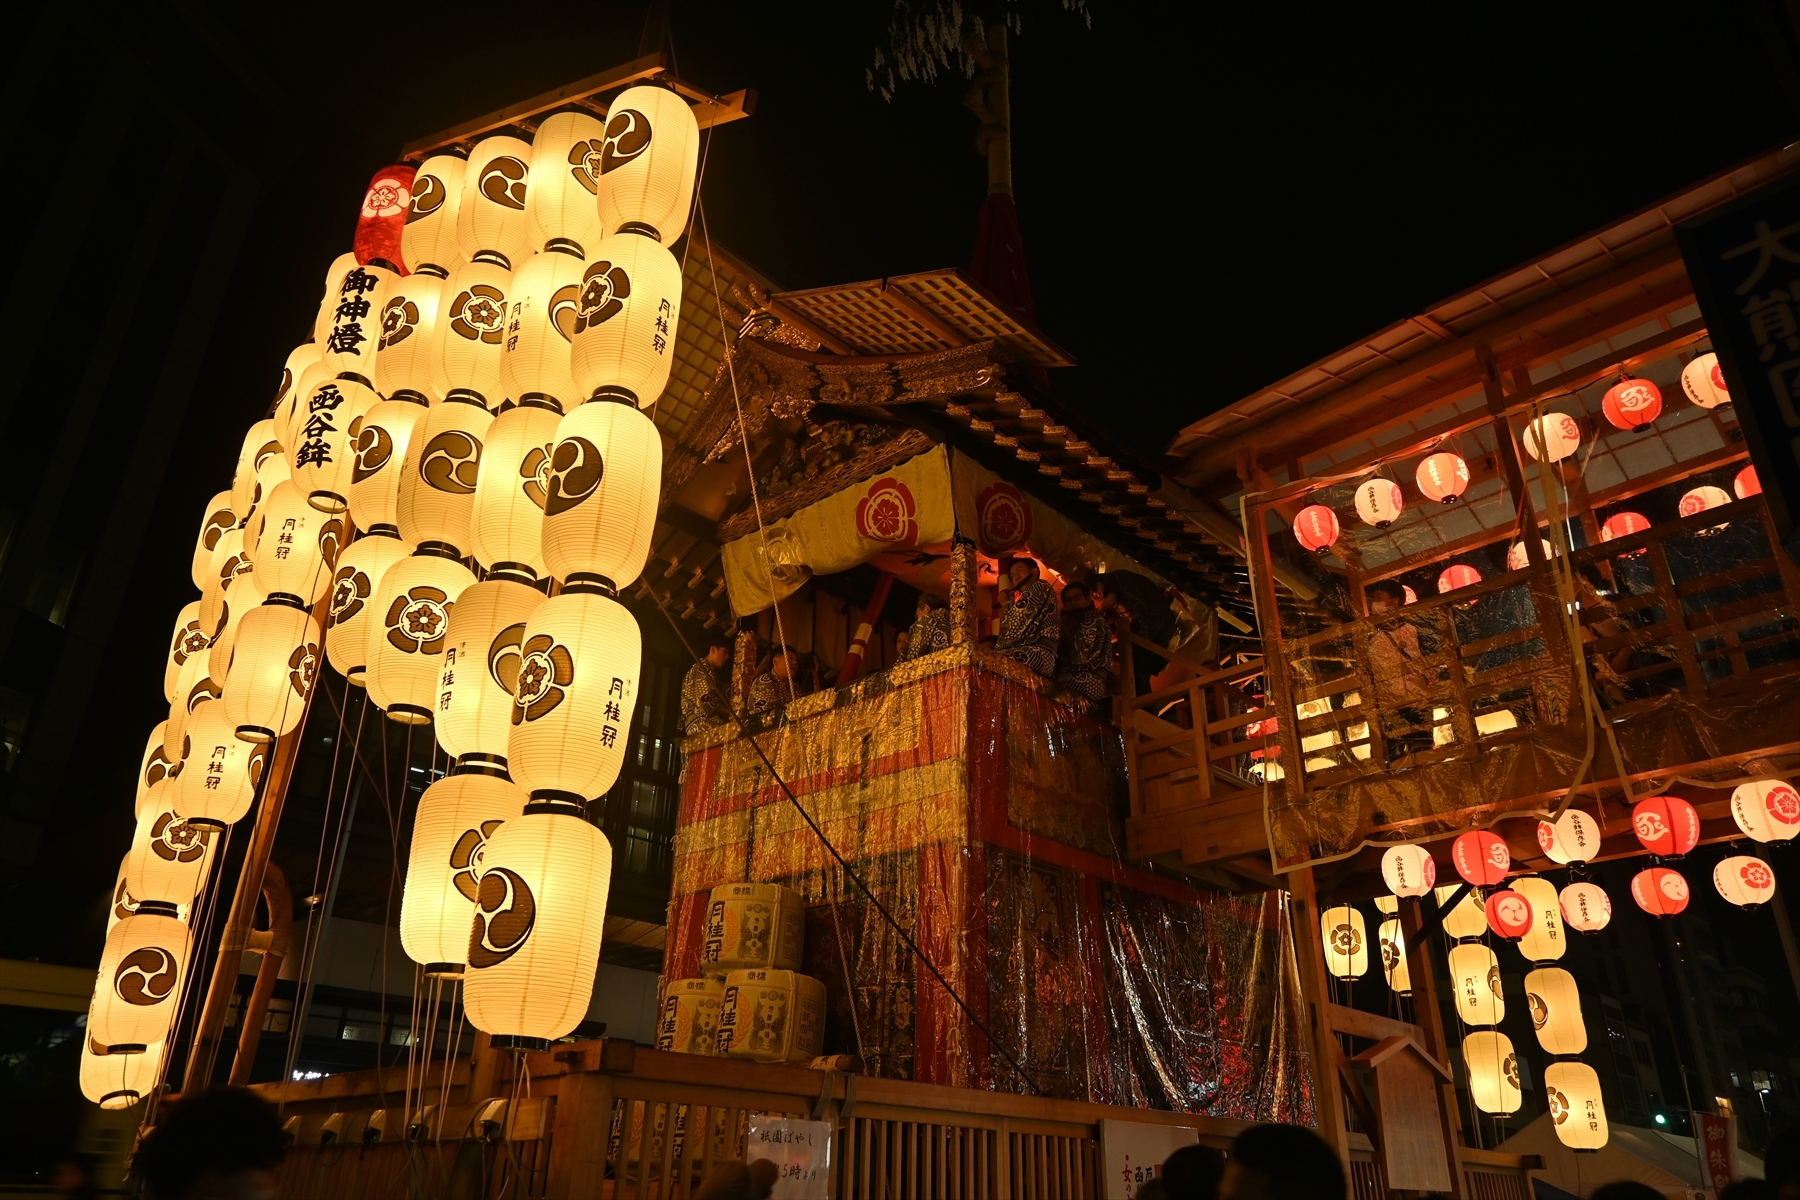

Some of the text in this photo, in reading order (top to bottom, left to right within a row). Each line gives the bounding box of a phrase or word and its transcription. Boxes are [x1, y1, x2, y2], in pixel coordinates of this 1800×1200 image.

[326, 266, 379, 356] 御神燈
[505, 301, 522, 353] 月桂冠
[652, 297, 671, 355] 月桂冠
[274, 518, 296, 560] 月桂冠
[439, 647, 457, 712] 月桂冠
[599, 676, 624, 749] 月桂冠
[204, 745, 226, 790] 月桂冠
[705, 900, 726, 963] 月桂冠
[1545, 910, 1557, 940] 月桂冠
[717, 986, 739, 1054] 月桂冠
[1465, 978, 1477, 1007] 月桂冠
[659, 995, 679, 1052] 月桂冠
[1586, 1100, 1598, 1132] 月桂冠
